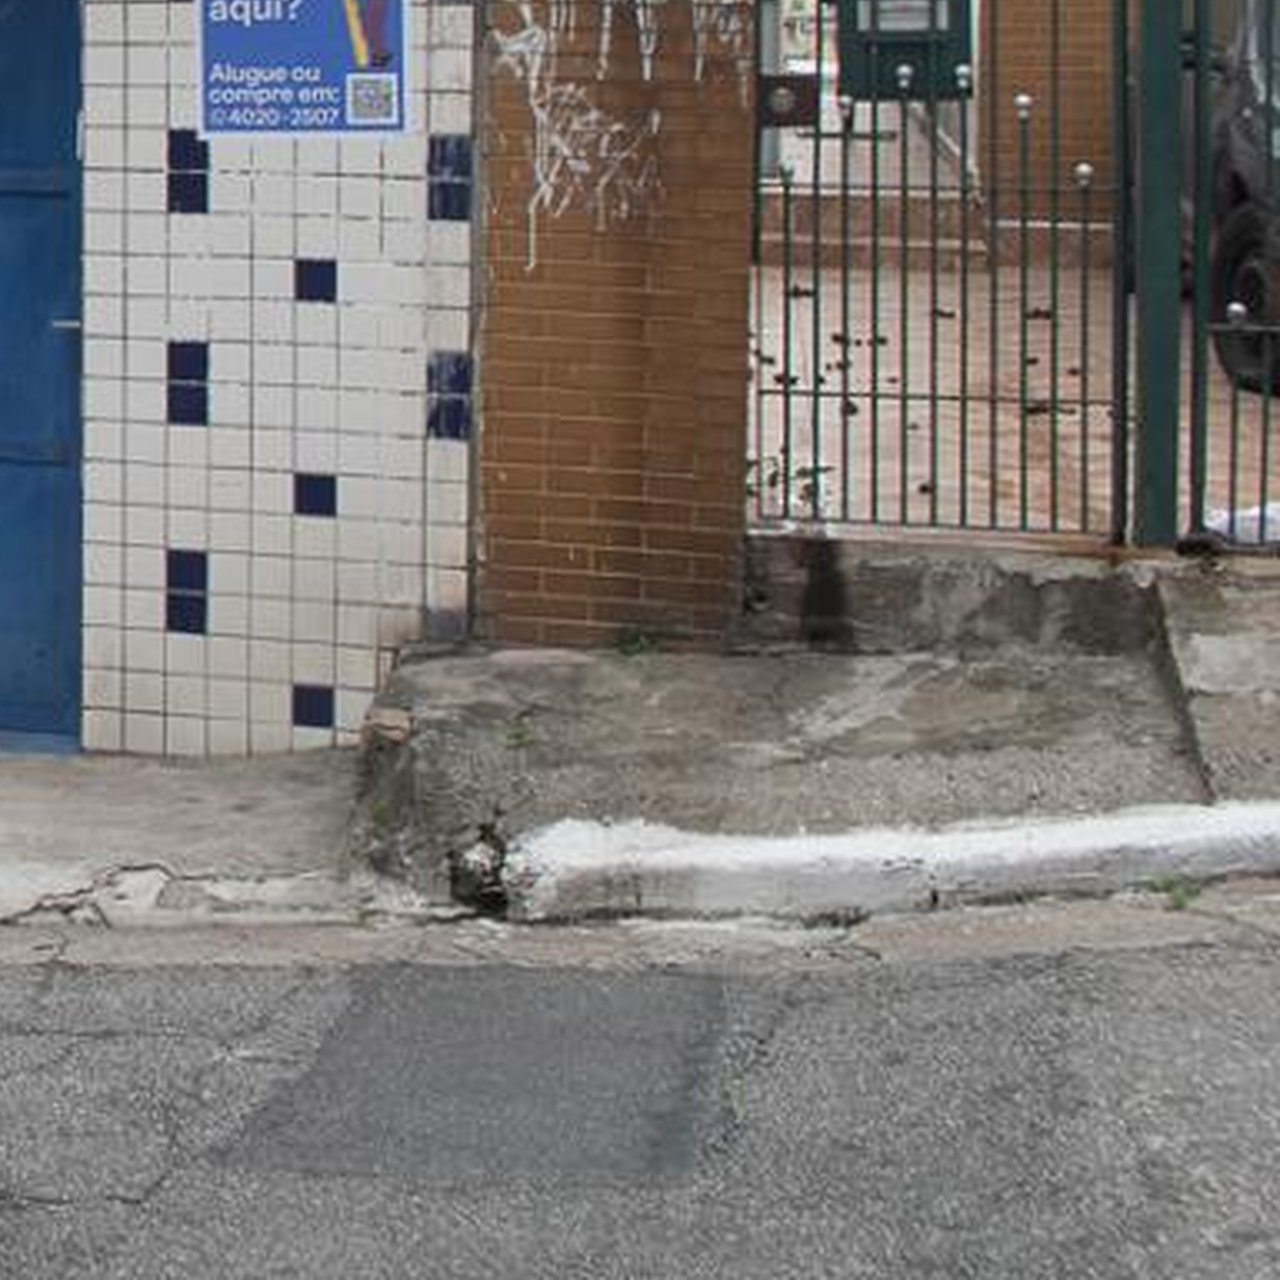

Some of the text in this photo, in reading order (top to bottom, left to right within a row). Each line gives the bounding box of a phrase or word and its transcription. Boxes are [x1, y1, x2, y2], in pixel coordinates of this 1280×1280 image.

[208, 63, 321, 87] Alugue ou
[208, 88, 294, 106] compre
